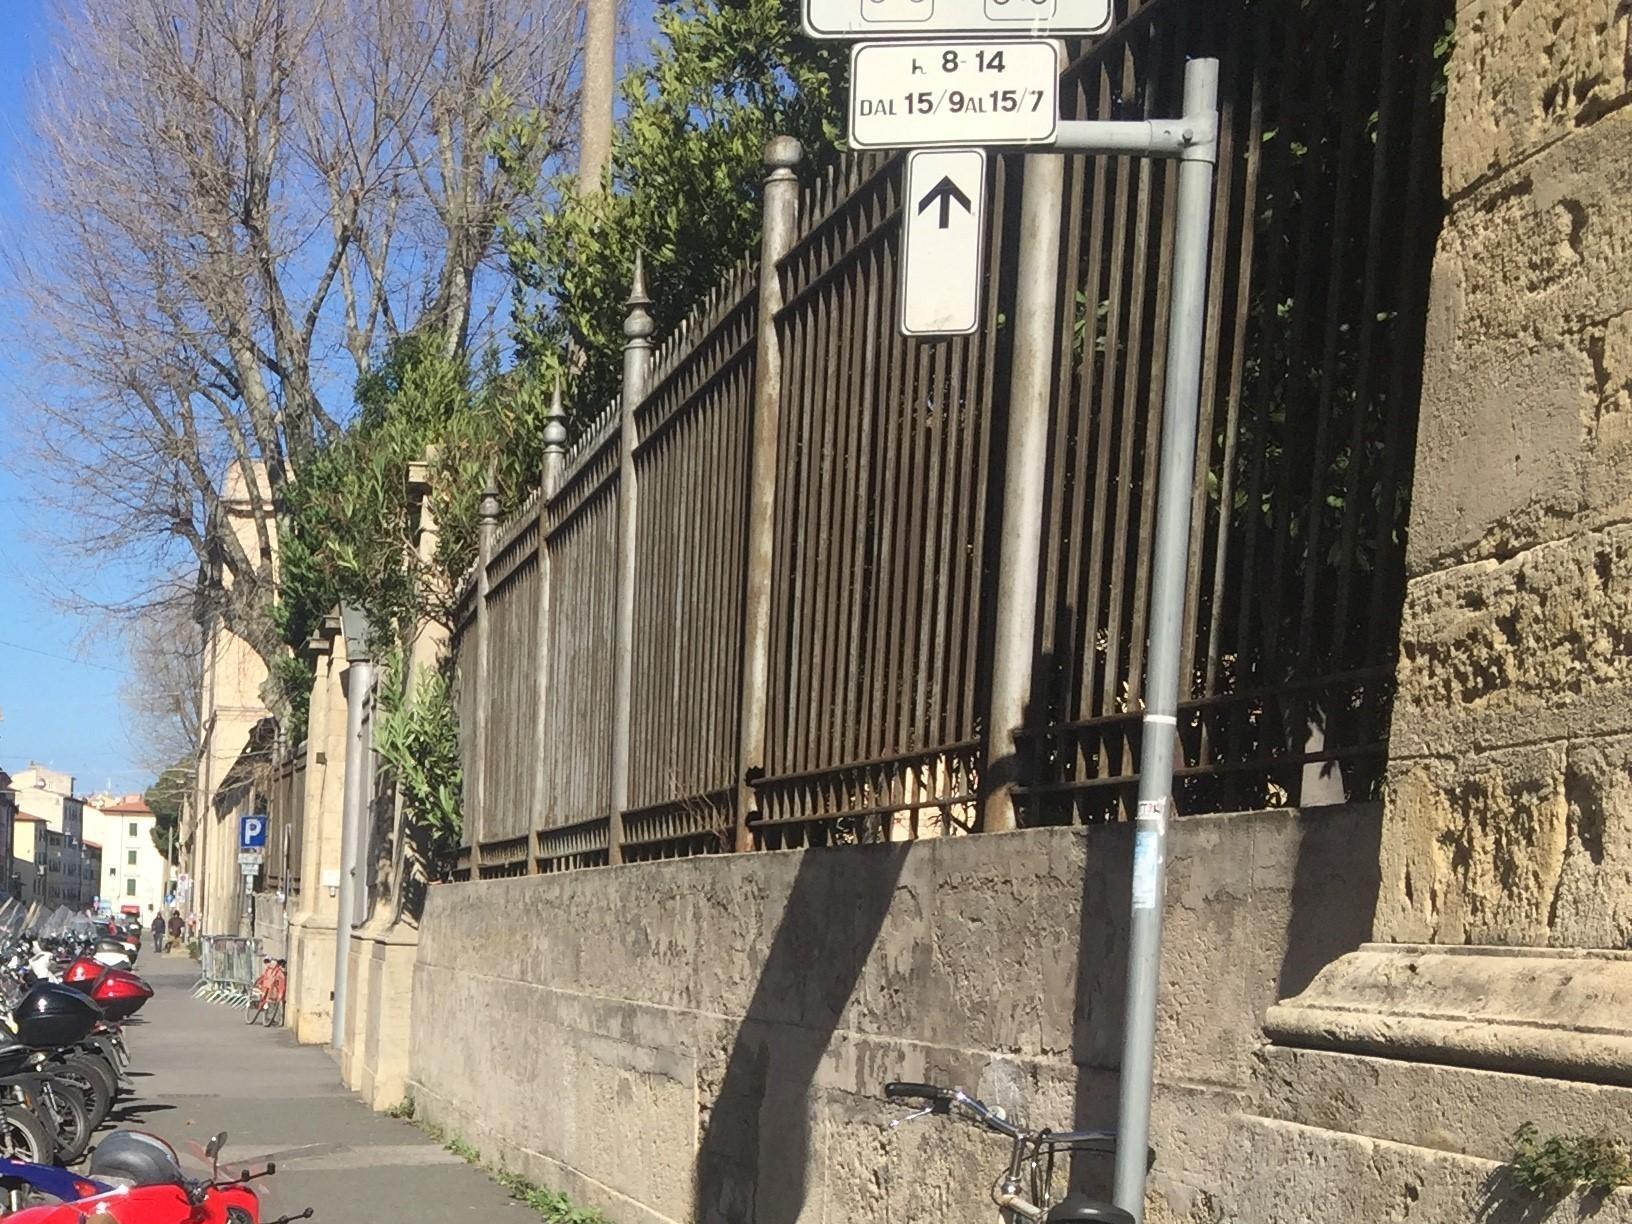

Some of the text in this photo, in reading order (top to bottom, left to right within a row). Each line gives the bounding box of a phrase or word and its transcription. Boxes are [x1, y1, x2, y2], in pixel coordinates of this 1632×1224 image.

[859, 88, 1045, 116] DAL 15/9 AL 15/7
[244, 818, 262, 845] P
